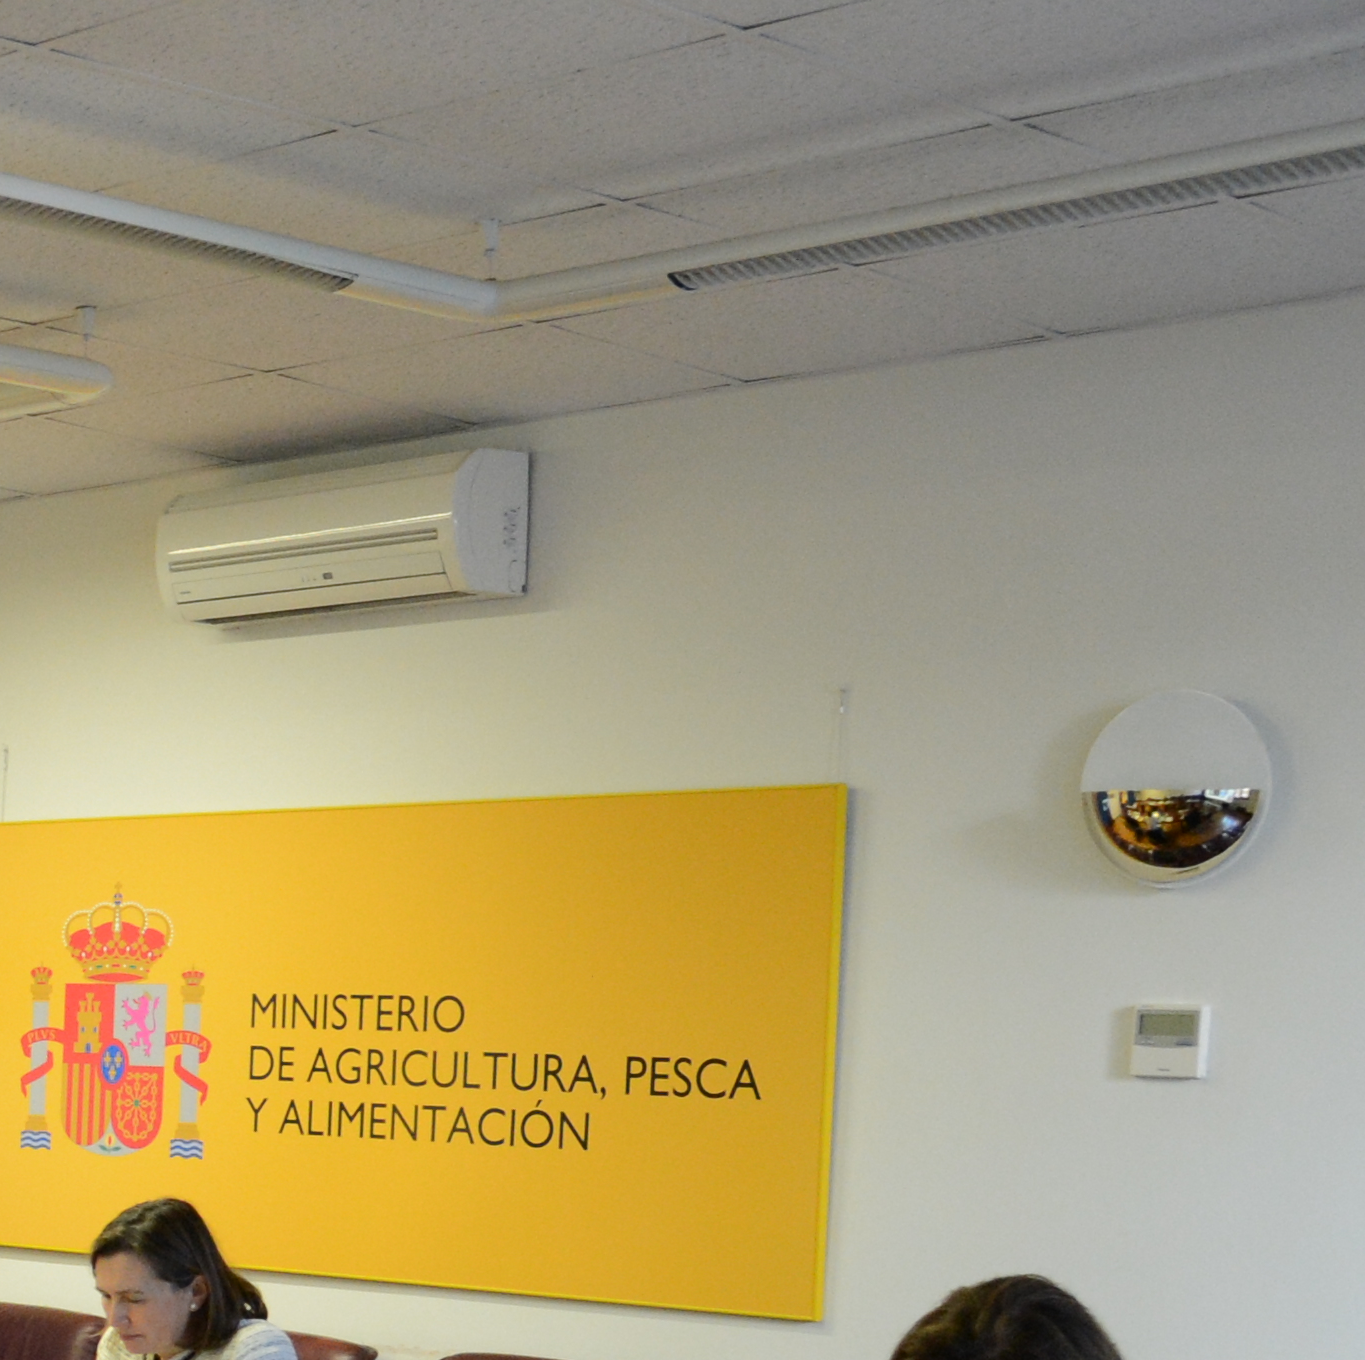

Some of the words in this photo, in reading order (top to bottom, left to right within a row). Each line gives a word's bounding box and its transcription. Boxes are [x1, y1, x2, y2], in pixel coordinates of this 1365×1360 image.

[250, 993, 466, 1033] MINISTERIO
[248, 1045, 295, 1082] DE
[306, 1047, 608, 1100] AGRICULTURA,
[624, 1056, 763, 1101] PESCA
[245, 1097, 269, 1133] Y
[278, 1098, 591, 1151] ALIMENTACIÓN
